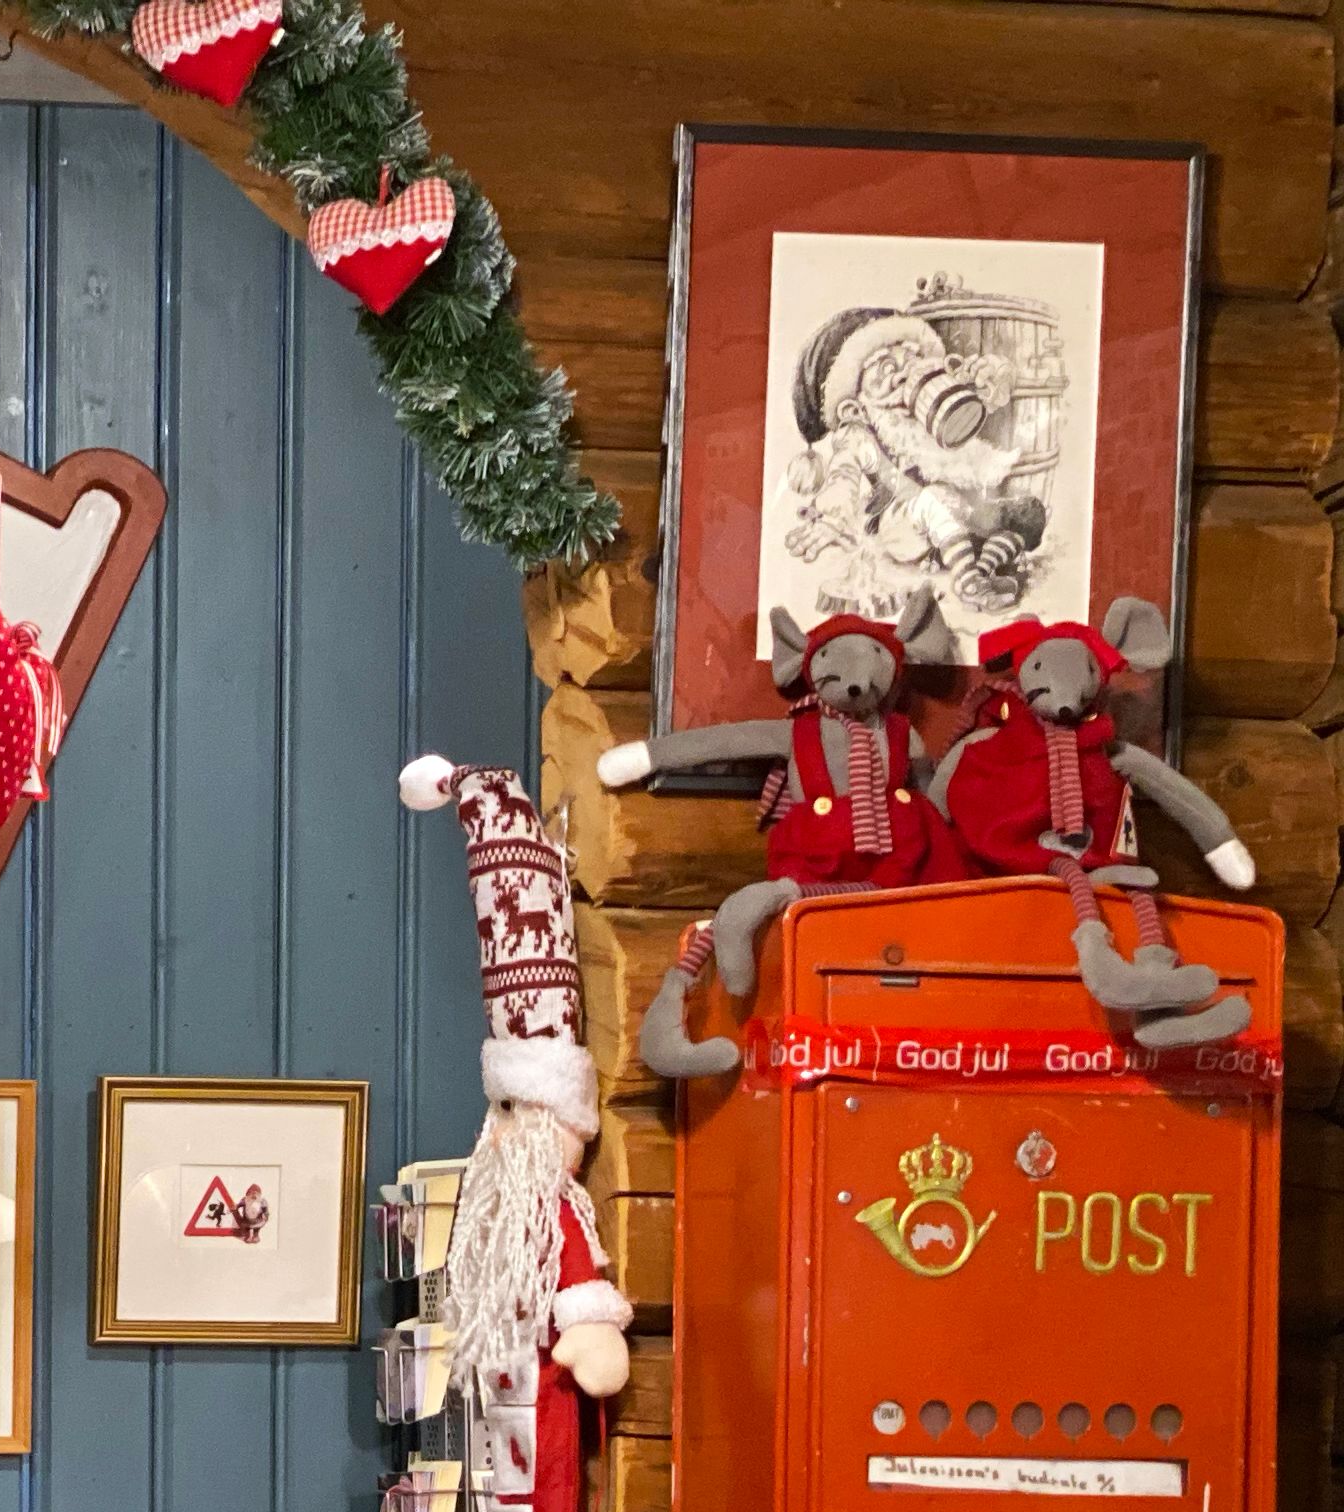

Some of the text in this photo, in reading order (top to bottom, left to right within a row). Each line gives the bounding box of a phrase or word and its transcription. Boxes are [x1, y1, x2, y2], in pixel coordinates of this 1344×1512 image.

[820, 1038, 861, 1073] jul
[896, 1040, 1010, 1077] God jul
[1045, 1043, 1112, 1072] God
[1195, 1047, 1257, 1073] God
[1035, 1190, 1213, 1278] POST
